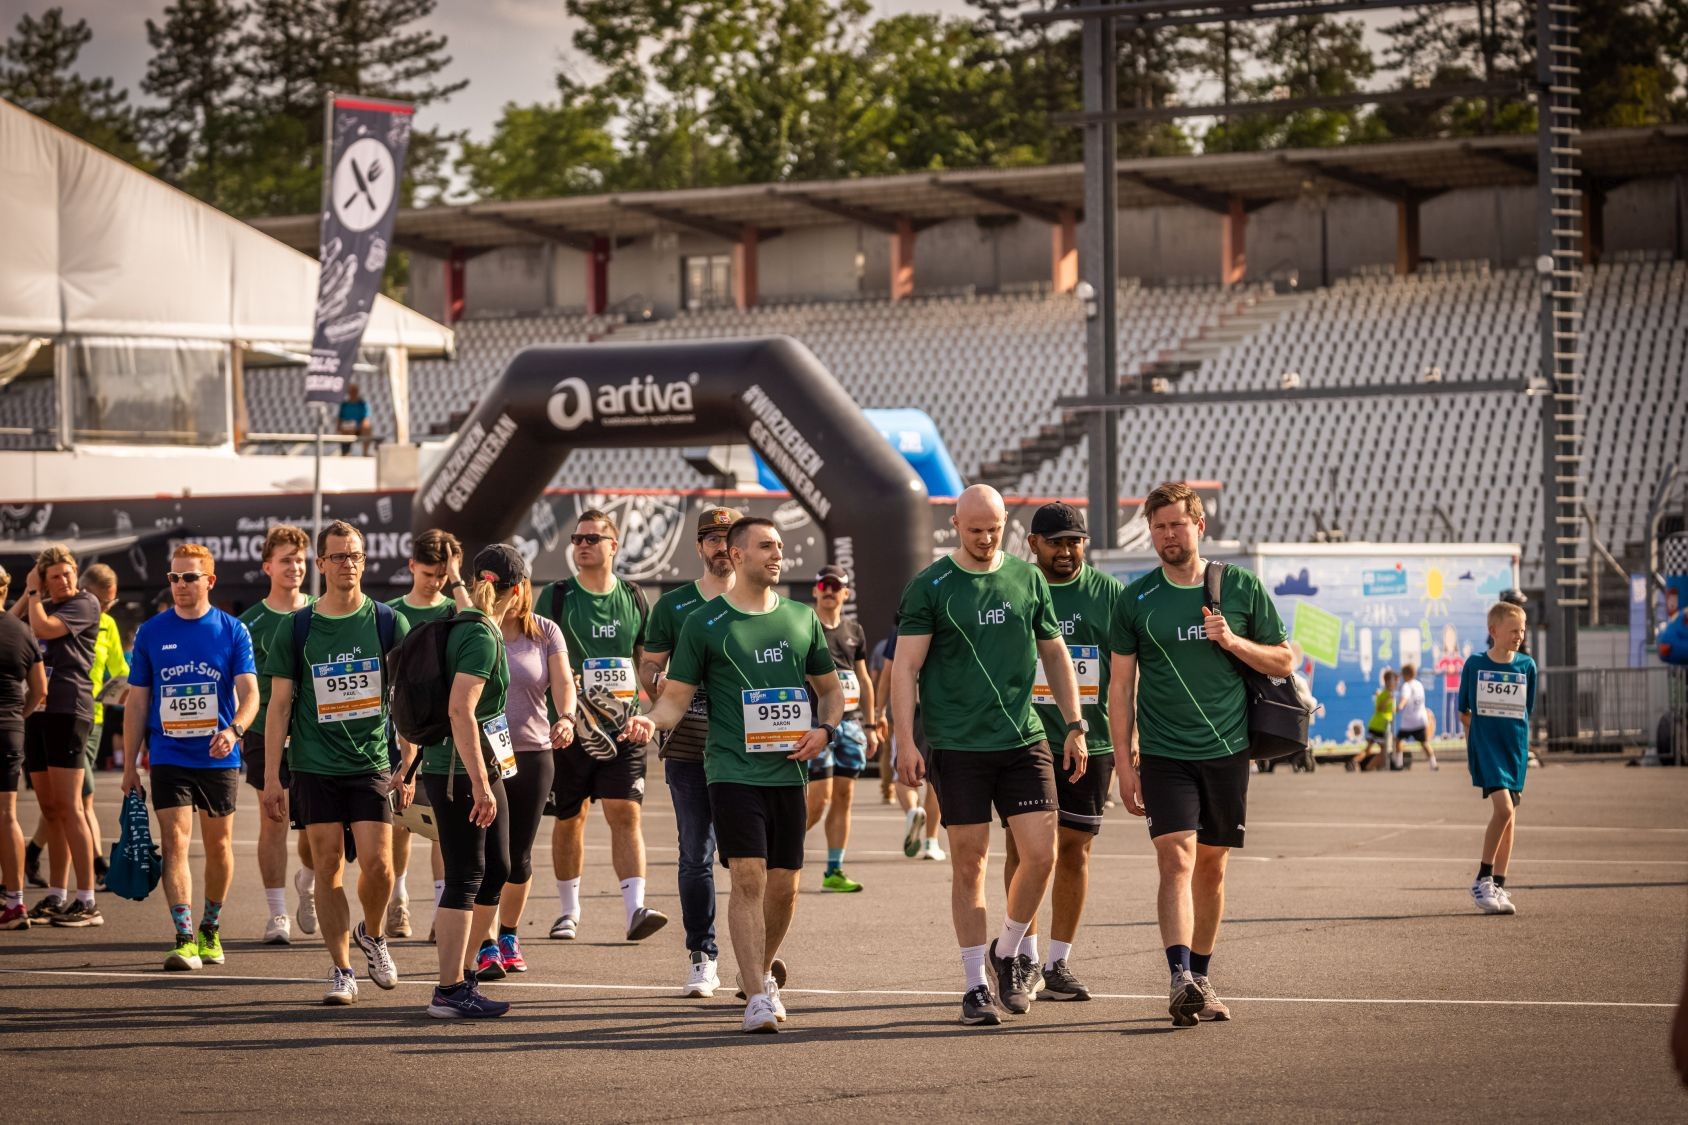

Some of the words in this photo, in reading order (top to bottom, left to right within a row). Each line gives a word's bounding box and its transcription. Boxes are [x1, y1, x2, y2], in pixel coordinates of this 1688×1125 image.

[596, 374, 693, 414] artiva
[443, 412, 518, 512] GEWINNERAN
[749, 419, 832, 520] GEWINNERAN
[161, 643, 178, 651] JAKO
[160, 660, 222, 682] Capri-Sun
[594, 670, 627, 682] 9558
[326, 674, 369, 693] 9553
[1486, 683, 1519, 696] 5647
[169, 697, 207, 712] 4656
[758, 704, 802, 721] 9559
